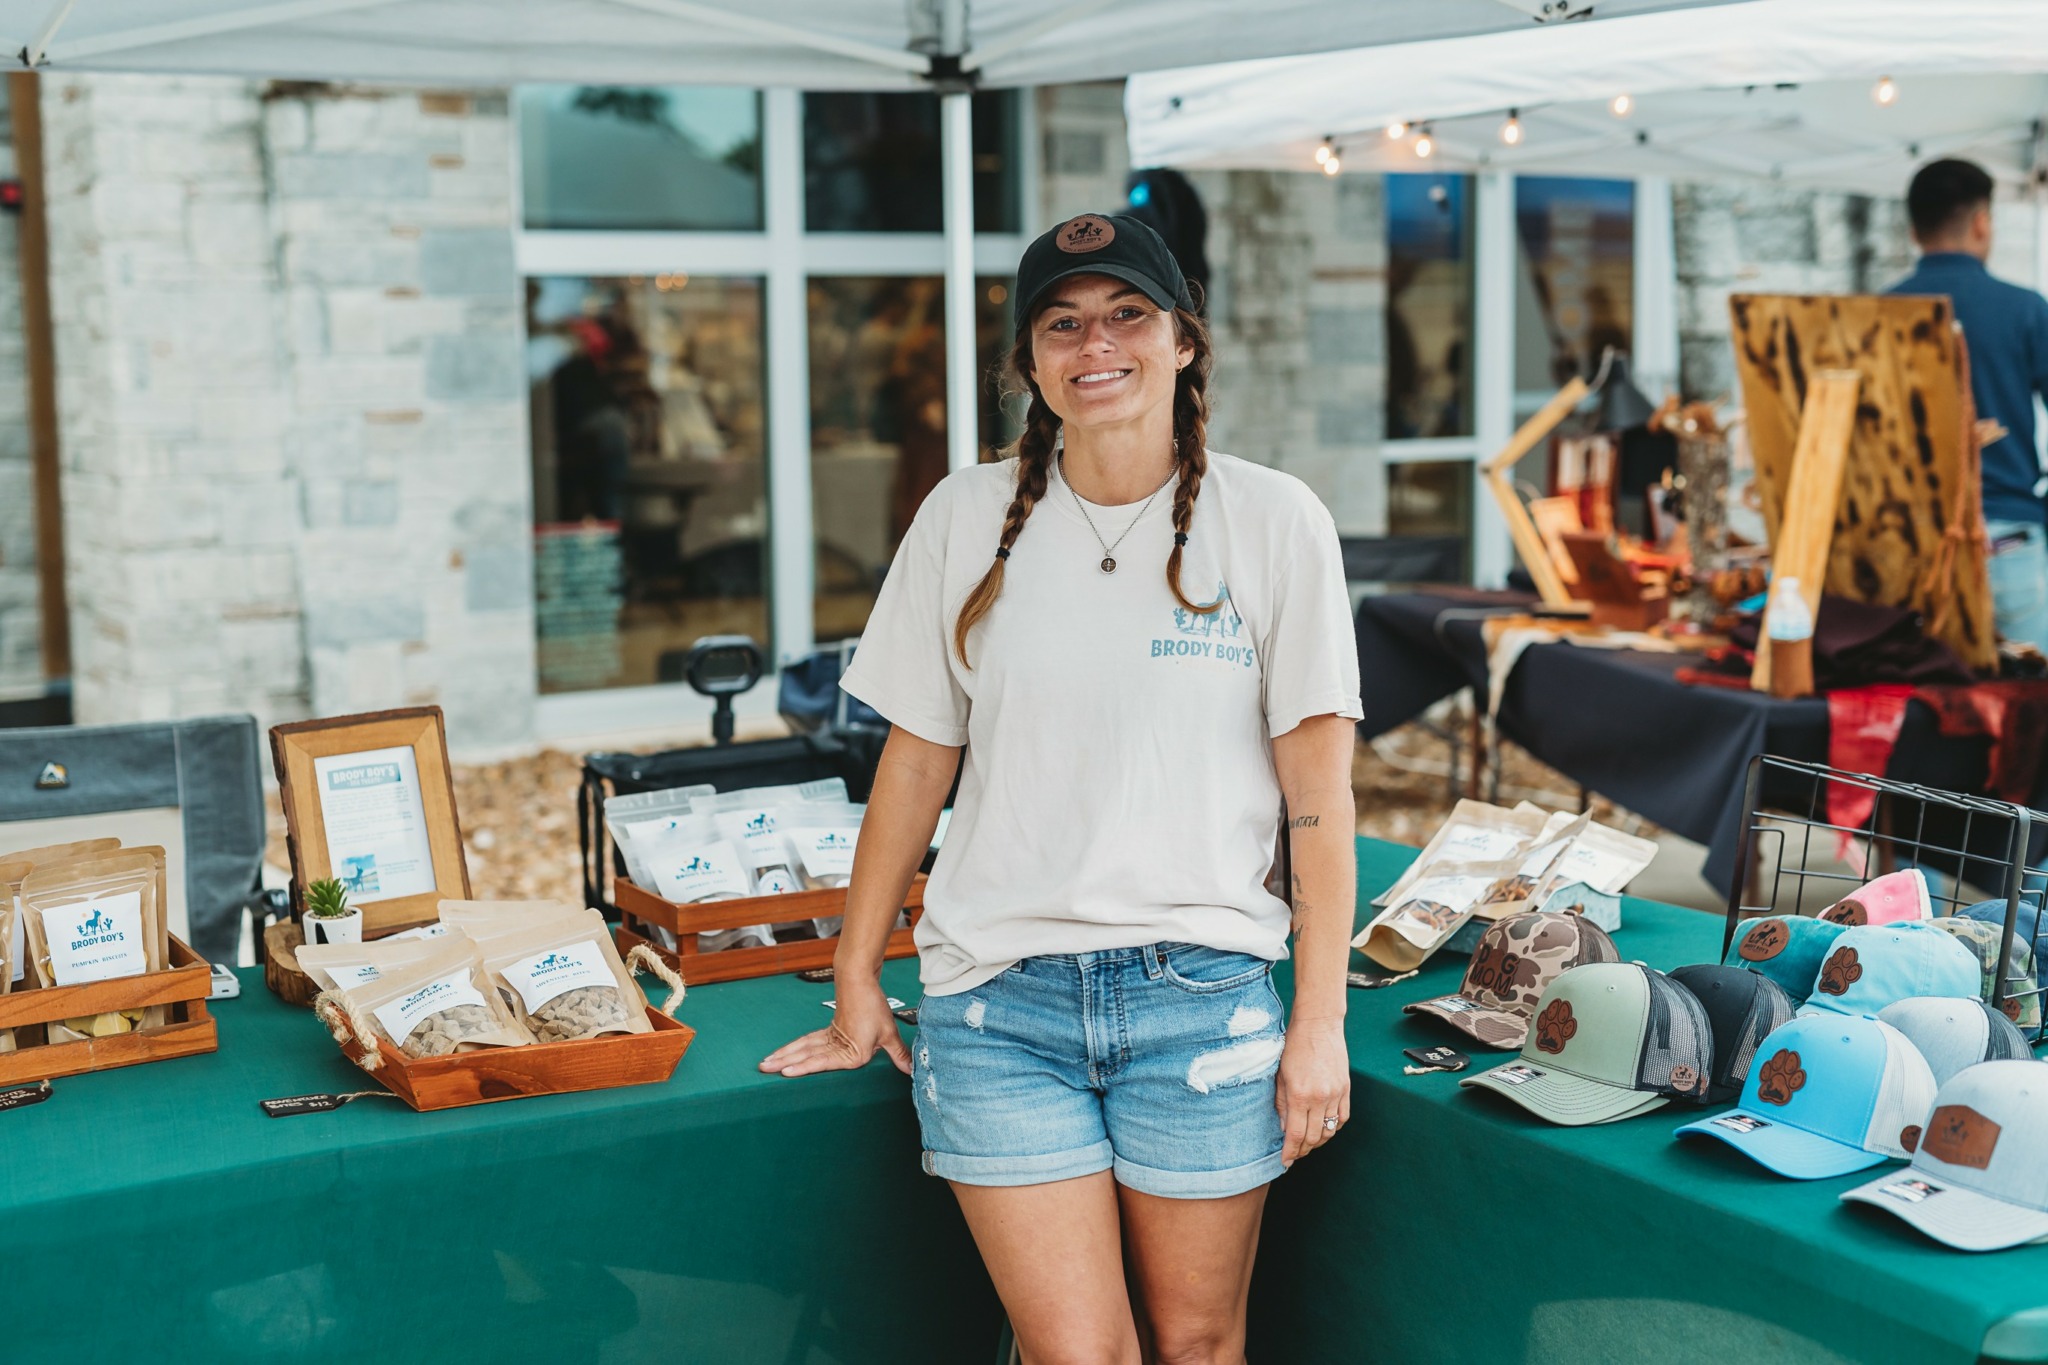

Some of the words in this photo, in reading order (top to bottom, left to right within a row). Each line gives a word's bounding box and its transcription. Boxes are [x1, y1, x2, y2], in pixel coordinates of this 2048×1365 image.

[1151, 640, 1212, 658] BRODY
[1216, 643, 1254, 667] BOY'S
[333, 769, 366, 784] BRODY
[367, 764, 396, 778] BOY'S
[72, 937, 99, 950] BRODY
[101, 932, 124, 943] BOY'S
[72, 959, 98, 968] PUMPKIN
[530, 966, 557, 978] BRODY
[558, 960, 583, 970] BOY'S
[1469, 962, 1514, 996] MOM
[400, 995, 426, 1011] BRODY
[427, 983, 451, 997] BOY'S
